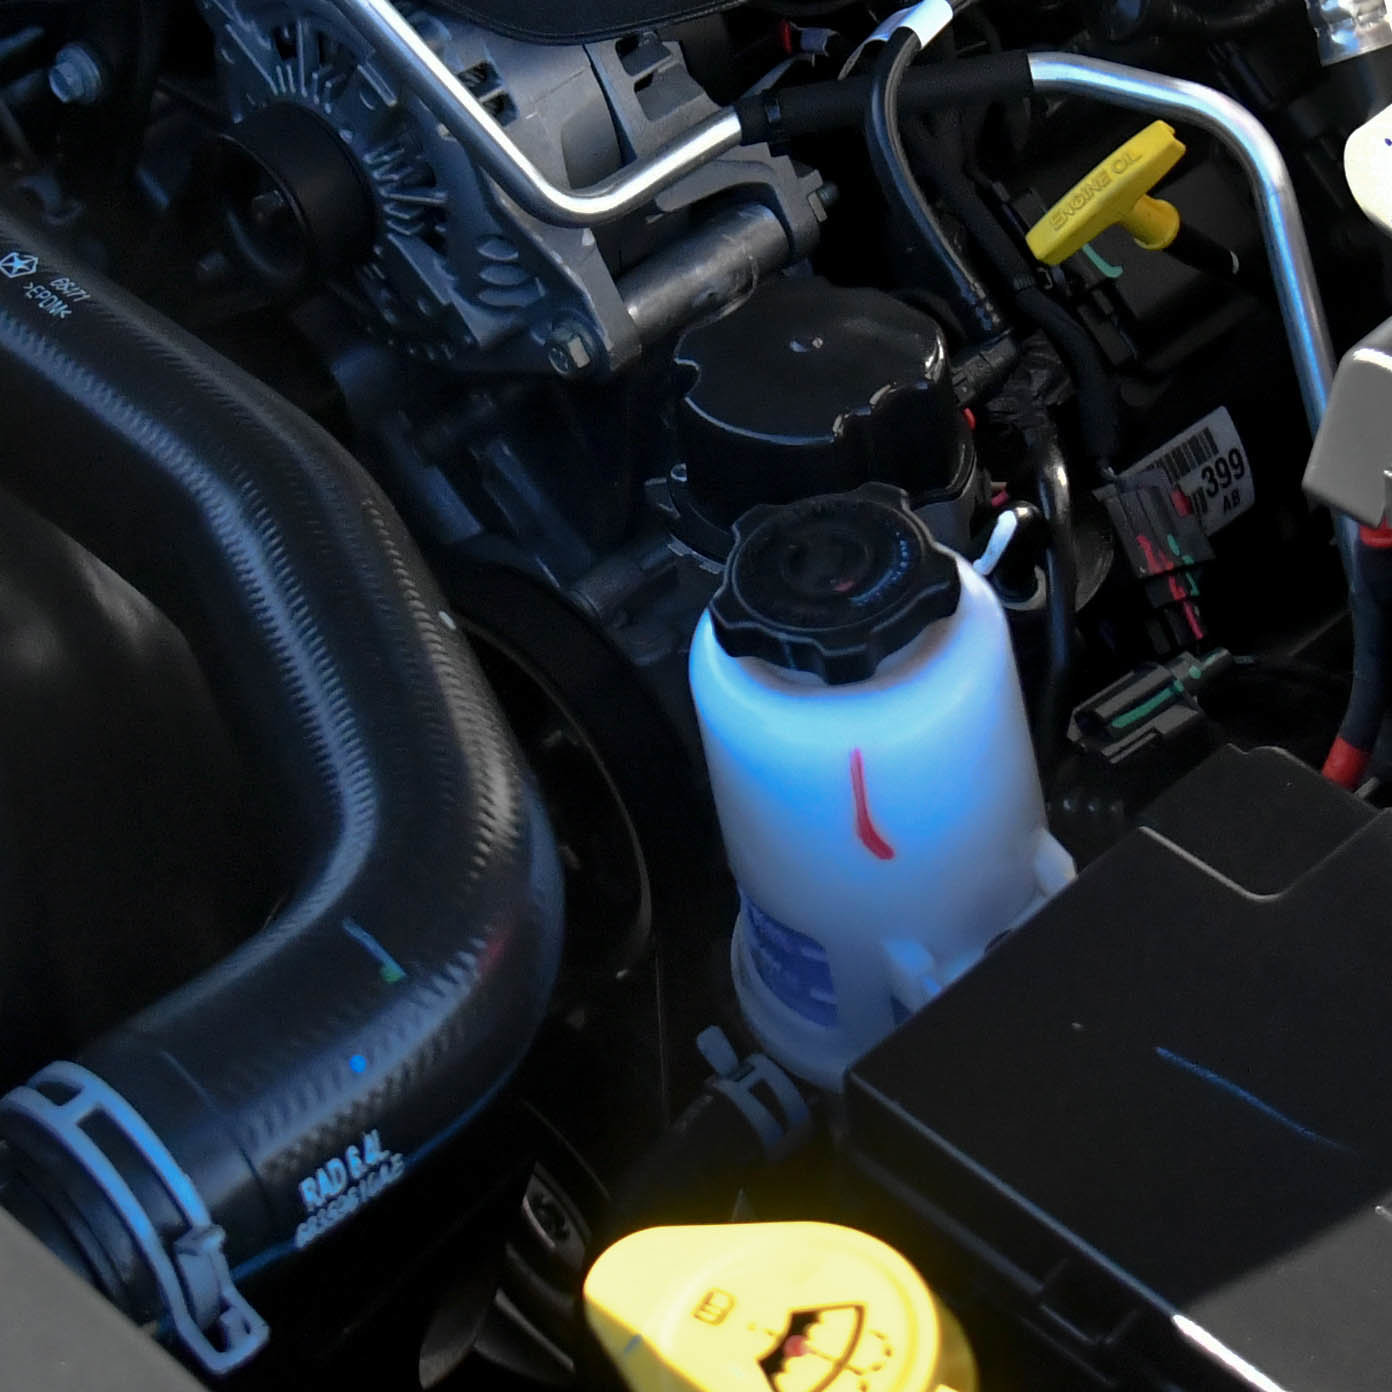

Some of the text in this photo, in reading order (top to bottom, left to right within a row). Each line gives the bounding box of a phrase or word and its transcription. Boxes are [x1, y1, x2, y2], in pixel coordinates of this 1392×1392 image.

[1049, 168, 1113, 232] ENGINE
[1201, 447, 1246, 500] 399
[1222, 492, 1242, 515] AB
[299, 1157, 348, 1212] RAD
